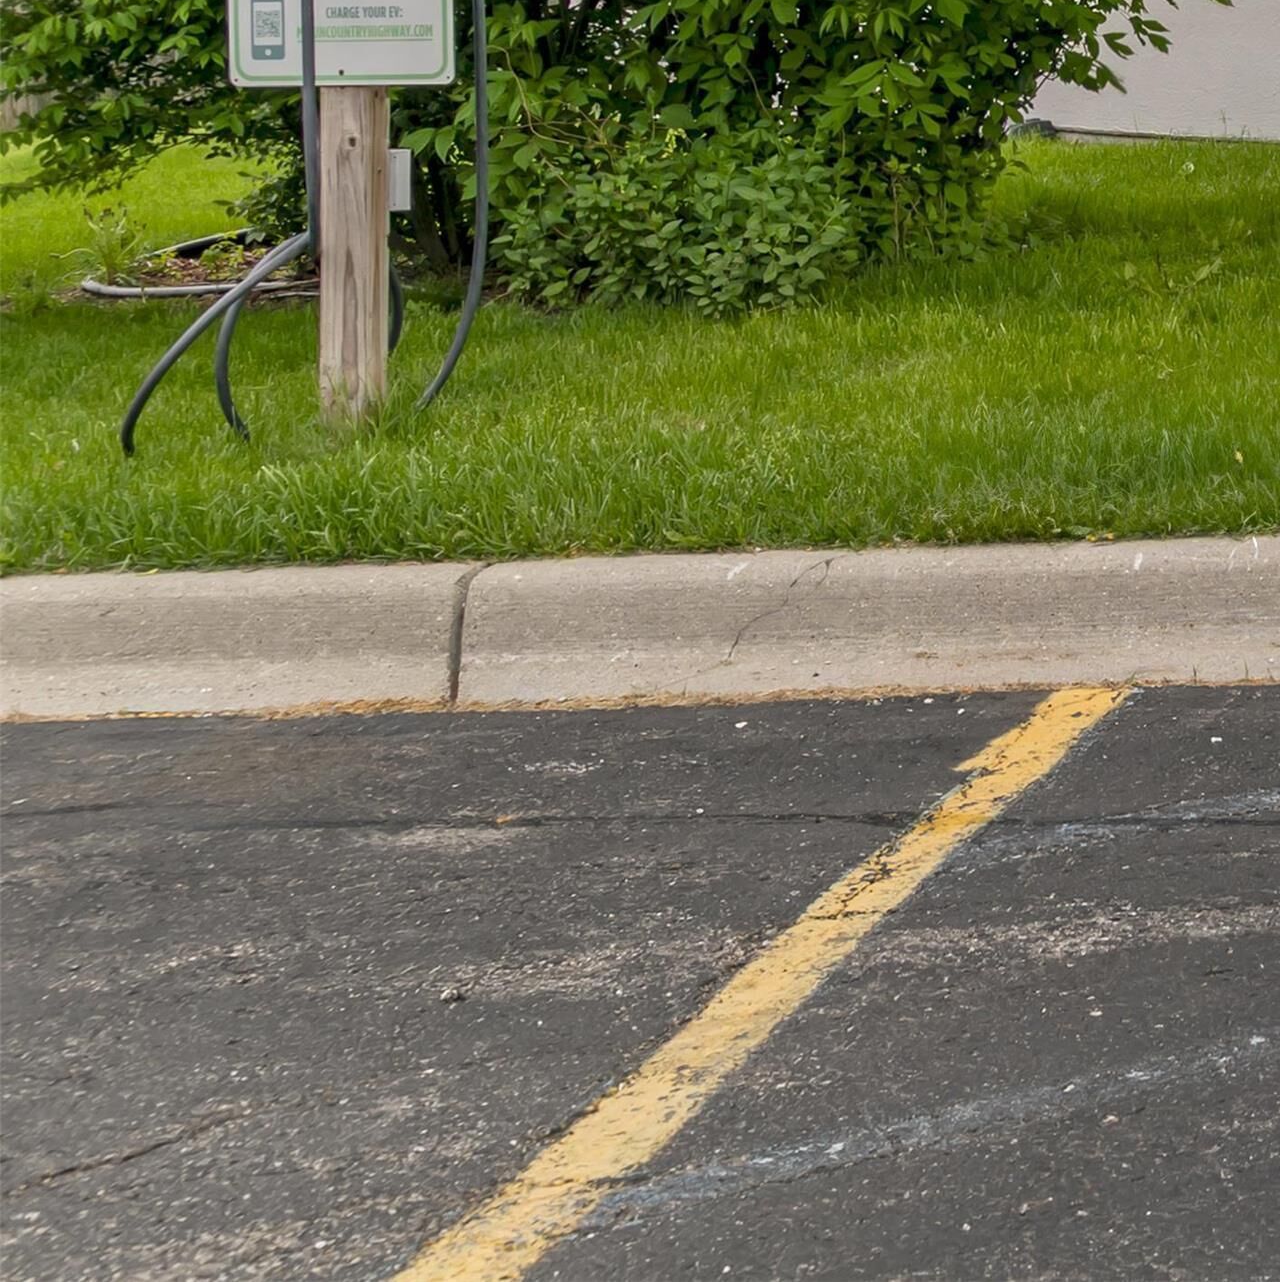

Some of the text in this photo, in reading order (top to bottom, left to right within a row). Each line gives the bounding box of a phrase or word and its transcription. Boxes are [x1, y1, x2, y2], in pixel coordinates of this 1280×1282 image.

[326, 6, 404, 19] CHARGE YOUR EV:
[297, 25, 433, 39] MUNCOUNTRYHIGHWAY.COM
